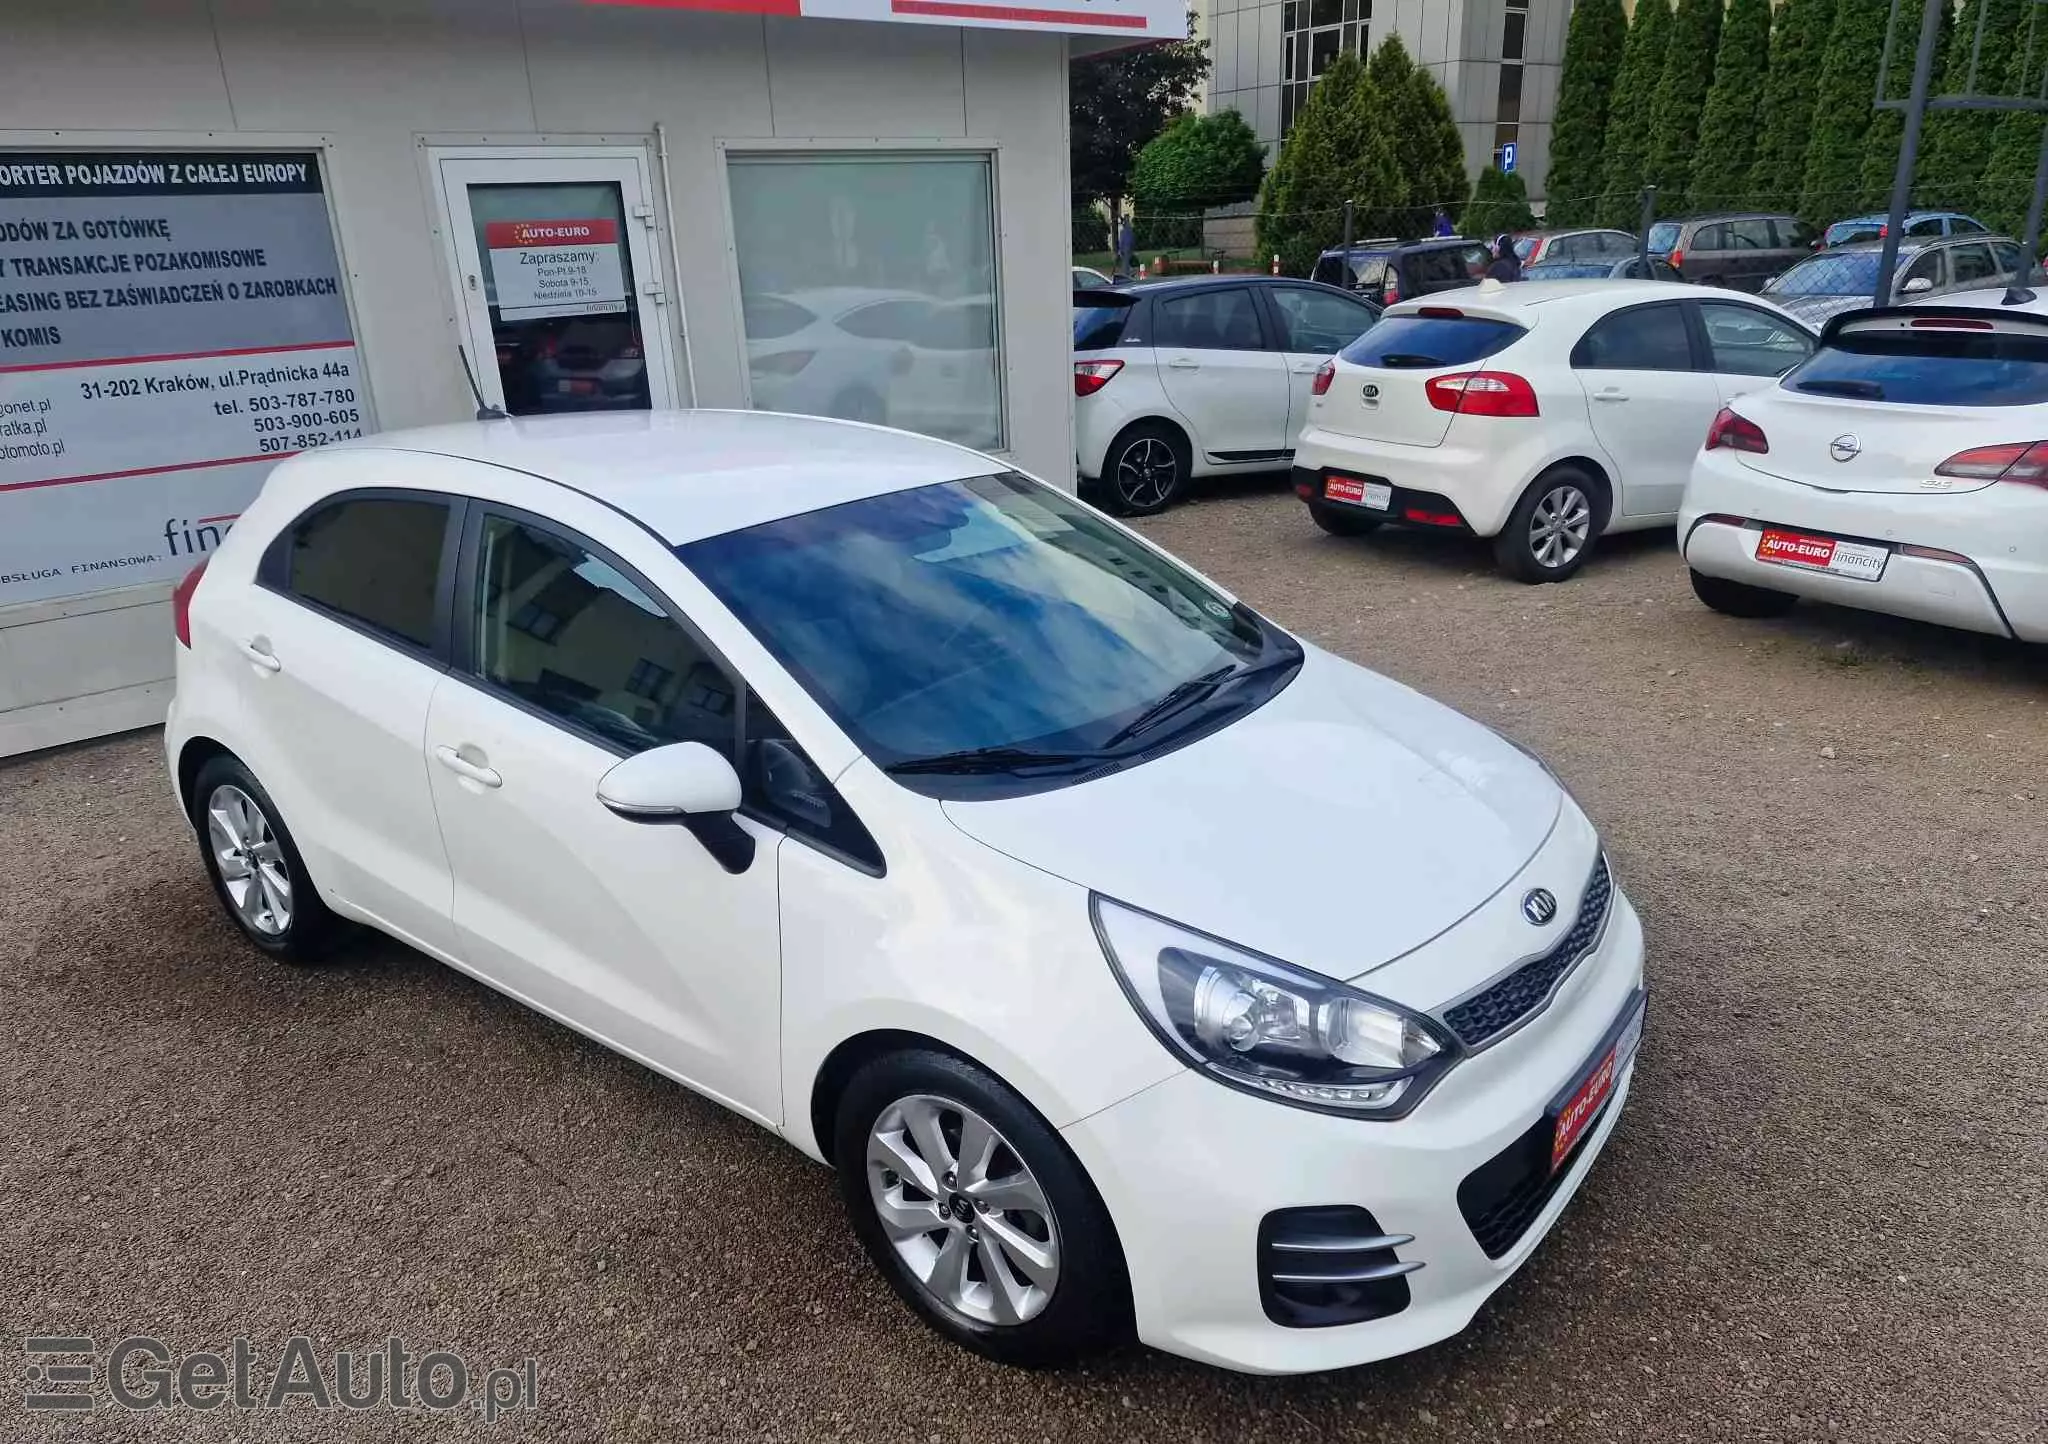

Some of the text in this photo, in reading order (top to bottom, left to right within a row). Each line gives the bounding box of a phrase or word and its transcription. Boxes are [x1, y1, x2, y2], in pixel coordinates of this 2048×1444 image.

[1504, 146, 1513, 170] P
[0, 160, 307, 185] ORTER POJAZDÓW Z CAŁEJ EUROPY
[52, 220, 79, 240] ZA
[82, 215, 172, 241] GOTÓWKĘ
[522, 226, 590, 238] AUTO-EURO
[10, 254, 131, 277] TRANSAKCJE
[133, 249, 267, 273] POZAKOMISOWE
[65, 289, 102, 309] BEZ
[103, 280, 224, 307] ZAŚWIADCZEŃ
[228, 282, 240, 300] O
[243, 277, 337, 299] ZAROBKACH
[539, 279, 569, 289] Sobota
[1, 326, 62, 348] KOMIS
[80, 379, 140, 400] 31-202
[219, 364, 319, 388] ul.Prądnicka
[322, 361, 350, 377] 44a
[214, 388, 355, 416] tel. 503-787-780
[254, 408, 360, 432] 503-900-605
[260, 428, 363, 453] 507-852-114
[1329, 483, 1362, 496] AUTO-EURO
[1766, 539, 1830, 558] AUTO-EURO
[0, 553, 163, 585] BSŁUGA FINANSOWA:
[1559, 1061, 1613, 1138] AUTO-EURO
